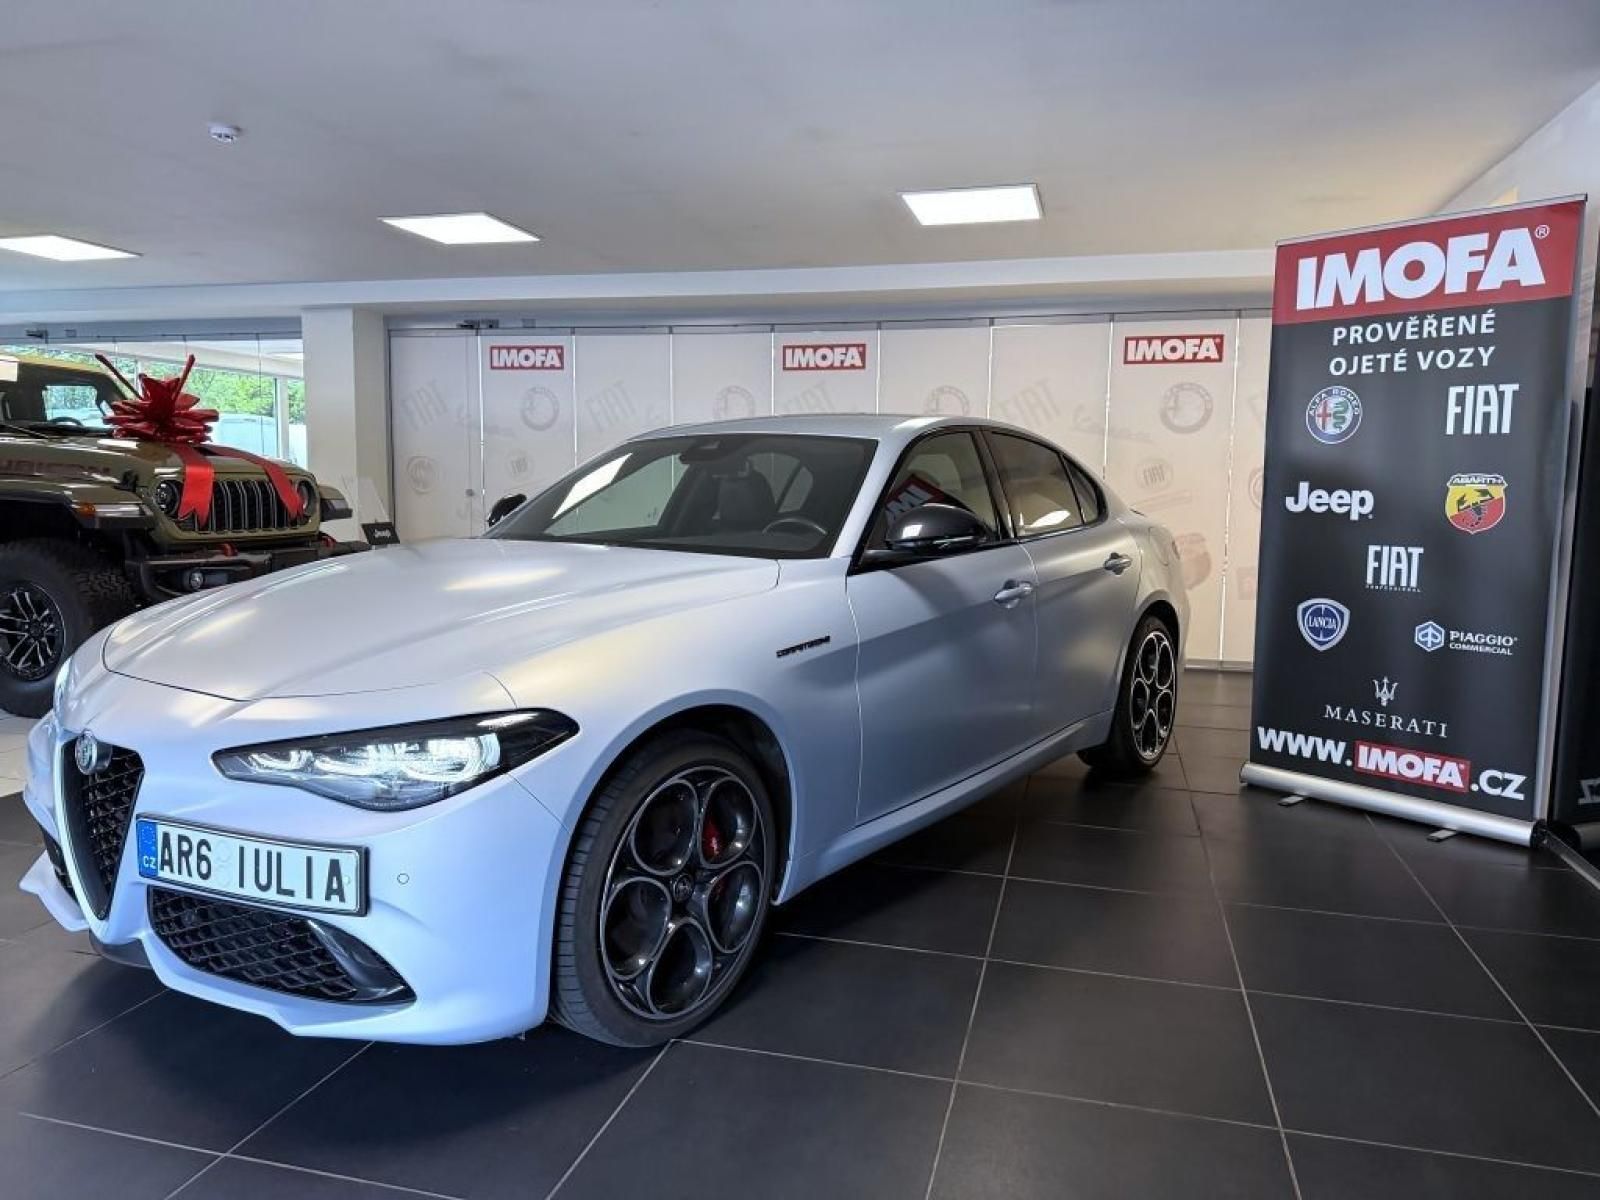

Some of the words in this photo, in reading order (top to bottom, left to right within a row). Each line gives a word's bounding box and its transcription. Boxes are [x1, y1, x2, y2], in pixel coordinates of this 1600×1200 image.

[1332, 309, 1496, 346] PROVĚŘENÉ
[492, 348, 561, 367] IMOFA
[785, 346, 862, 368] IMOFA
[1126, 338, 1219, 361] IMOFA
[1329, 348, 1407, 375] OJETÉ
[1417, 346, 1495, 371] VOZY
[1446, 383, 1519, 435] FIAT
[1286, 481, 1374, 521] Jeep
[1366, 544, 1424, 588] FIAT
[1449, 630, 1514, 647] PIAGGIO
[1324, 704, 1448, 739] MASERATI
[142, 856, 157, 869] CZ
[160, 831, 212, 880] AR6
[238, 845, 346, 903] IULIA
